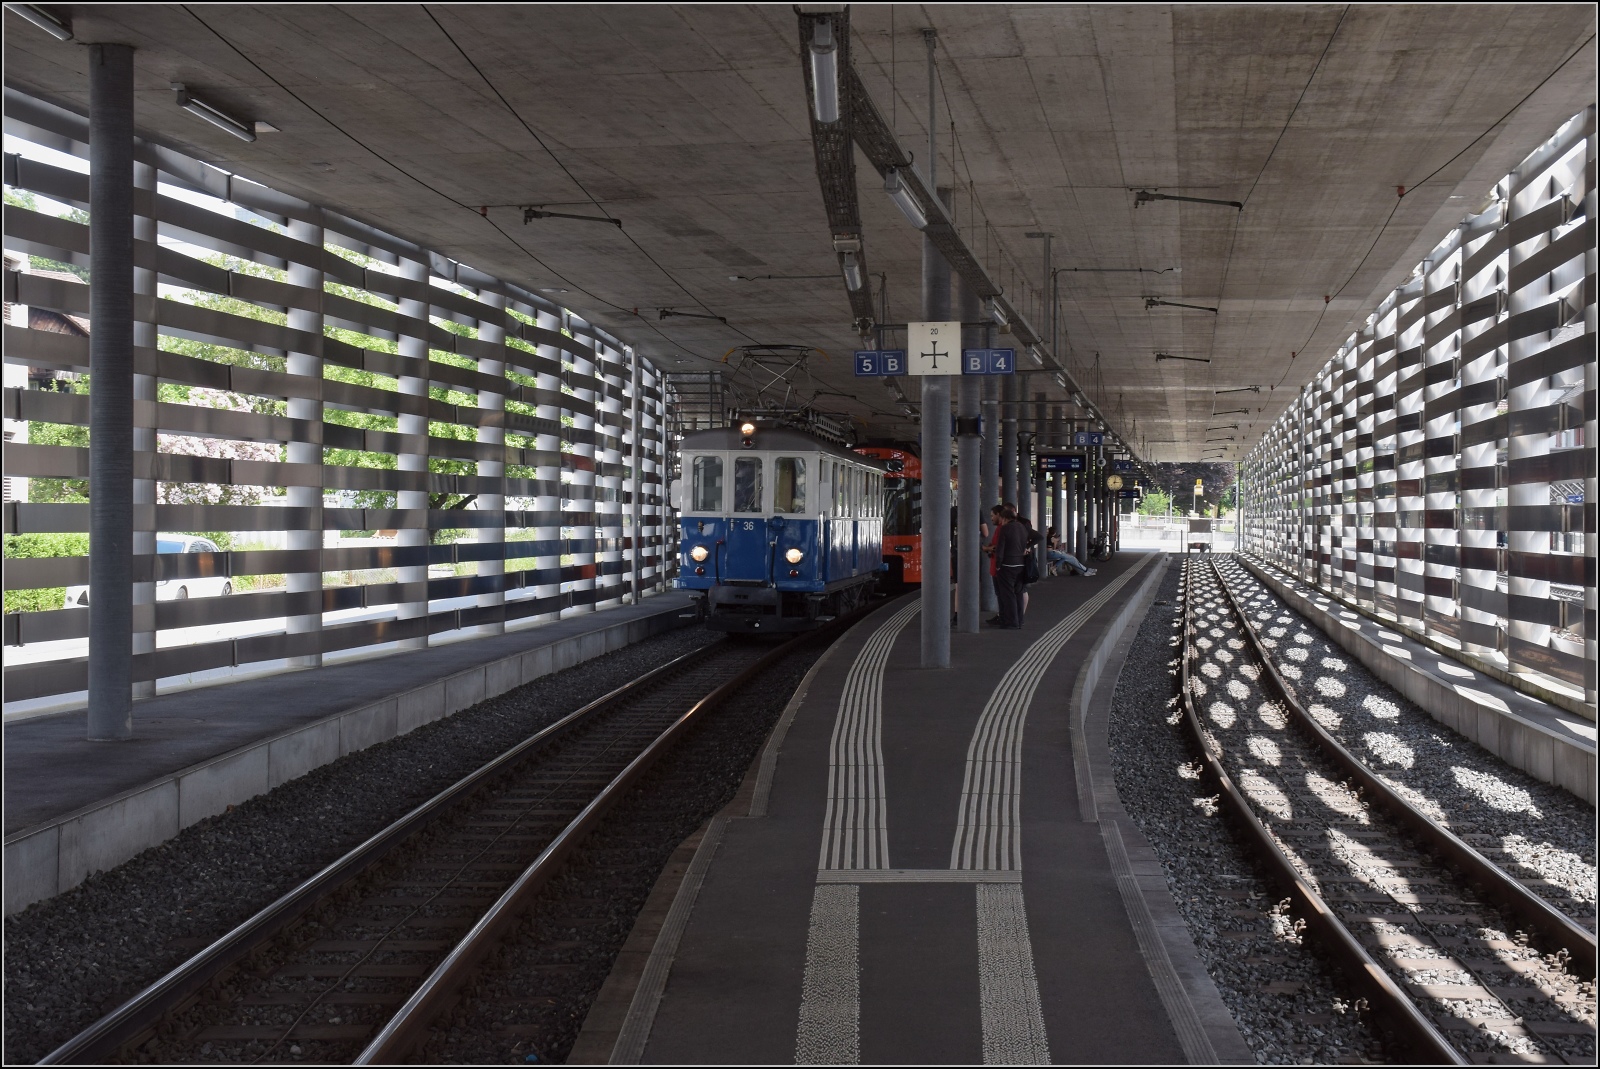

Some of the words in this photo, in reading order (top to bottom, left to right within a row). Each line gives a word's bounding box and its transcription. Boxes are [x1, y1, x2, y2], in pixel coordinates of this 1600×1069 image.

[930, 327, 939, 336] 20
[862, 358, 873, 372] 5
[887, 358, 899, 371] B
[970, 357, 981, 371] B
[995, 357, 1007, 370] 4
[1079, 436, 1086, 444] B
[1092, 436, 1099, 444] 4
[743, 521, 755, 532] 36
